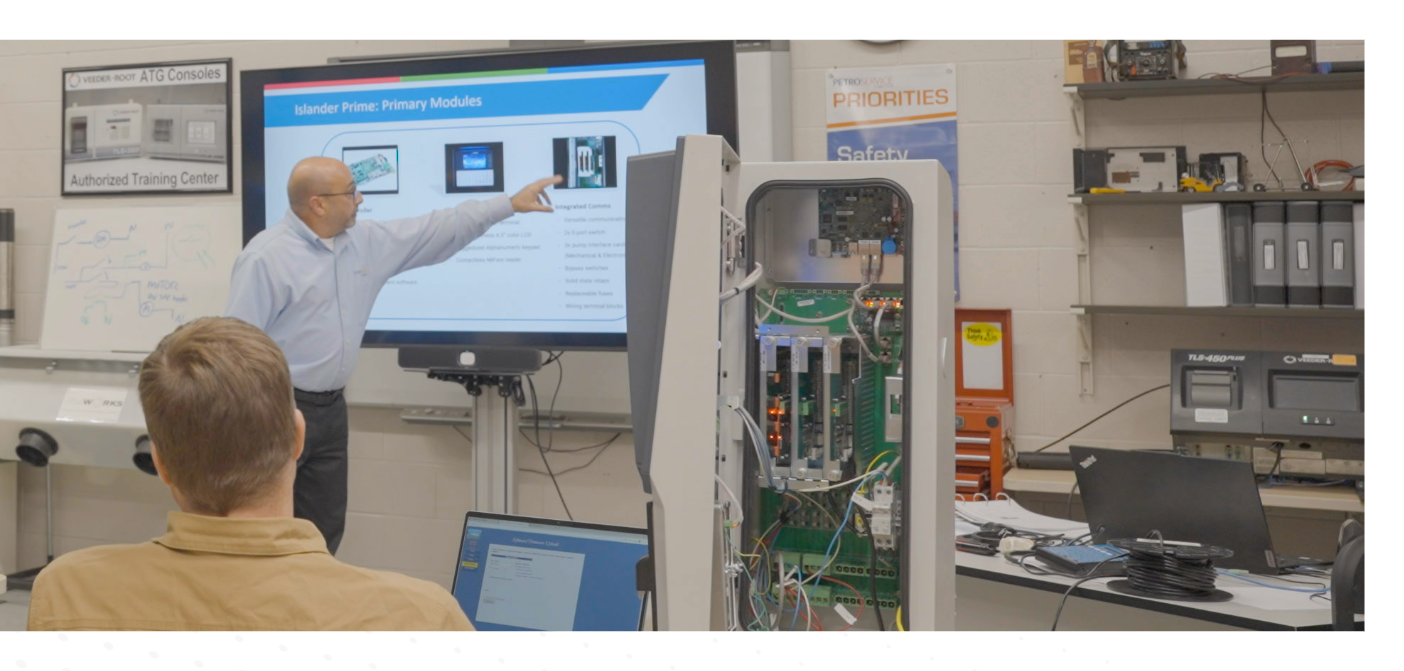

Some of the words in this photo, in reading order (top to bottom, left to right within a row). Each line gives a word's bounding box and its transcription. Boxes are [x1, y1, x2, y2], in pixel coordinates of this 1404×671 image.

[82, 73, 137, 84] VEEDER-ROOT
[140, 69, 165, 83] ATG
[168, 66, 221, 82] Consoles
[295, 103, 339, 116] Islander
[342, 101, 379, 113] Prime:
[382, 99, 427, 112] Primary
[430, 95, 482, 109] Modules
[832, 88, 949, 108] PRIORITIES
[70, 173, 129, 187] Authorized
[131, 171, 177, 188] Training
[180, 171, 219, 185] Center
